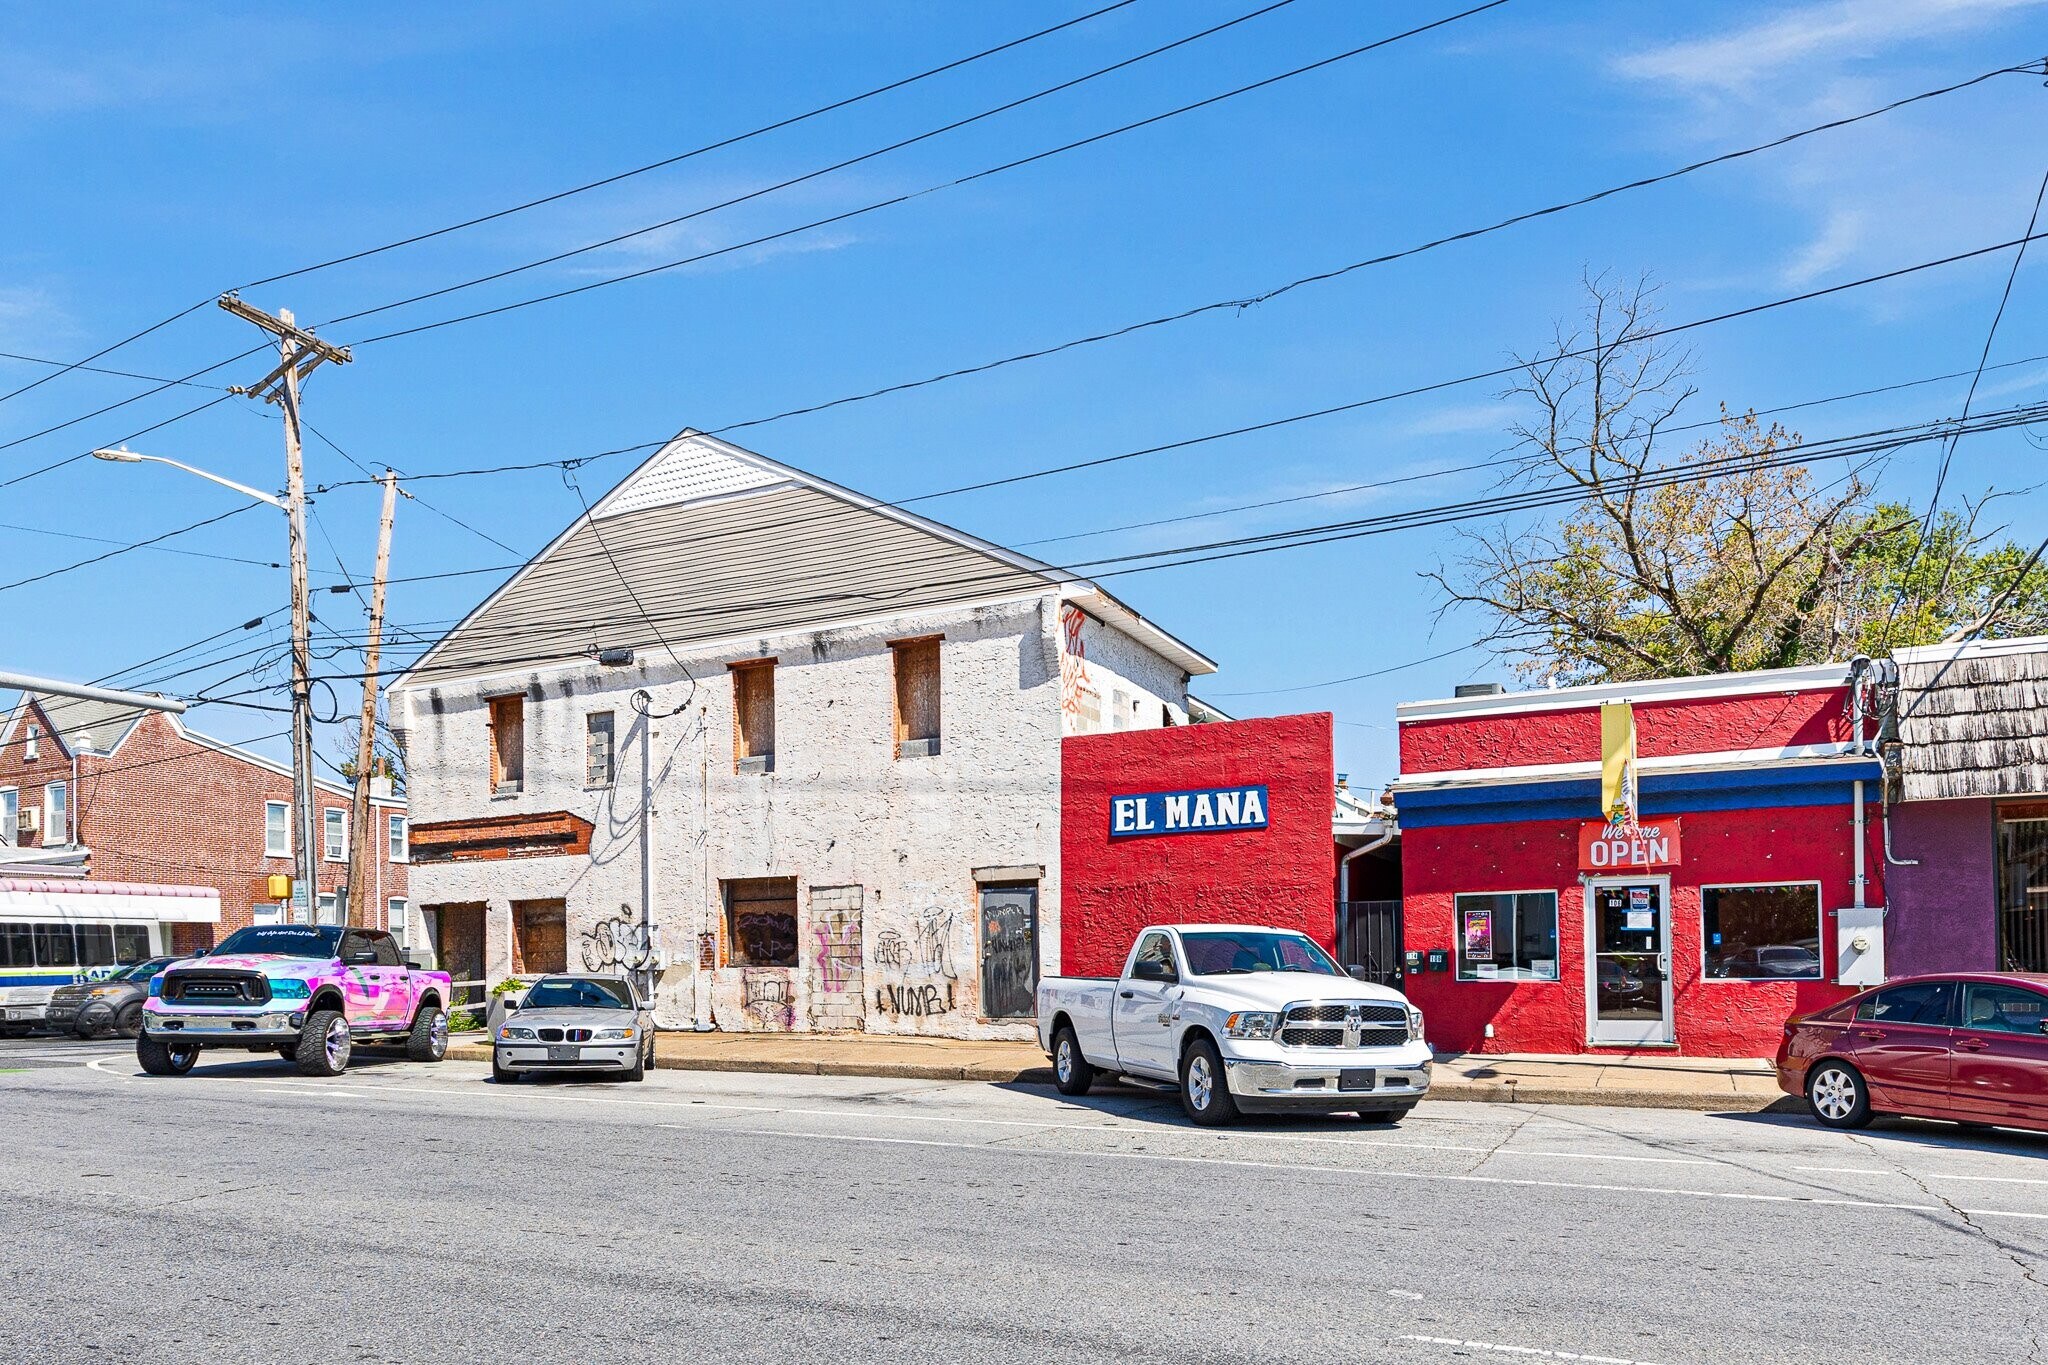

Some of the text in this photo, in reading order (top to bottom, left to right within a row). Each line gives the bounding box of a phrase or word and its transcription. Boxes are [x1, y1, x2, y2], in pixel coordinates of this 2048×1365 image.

[1114, 790, 1265, 831] EL MANA
[1601, 824, 1624, 840] We
[1590, 837, 1669, 867] OPEN
